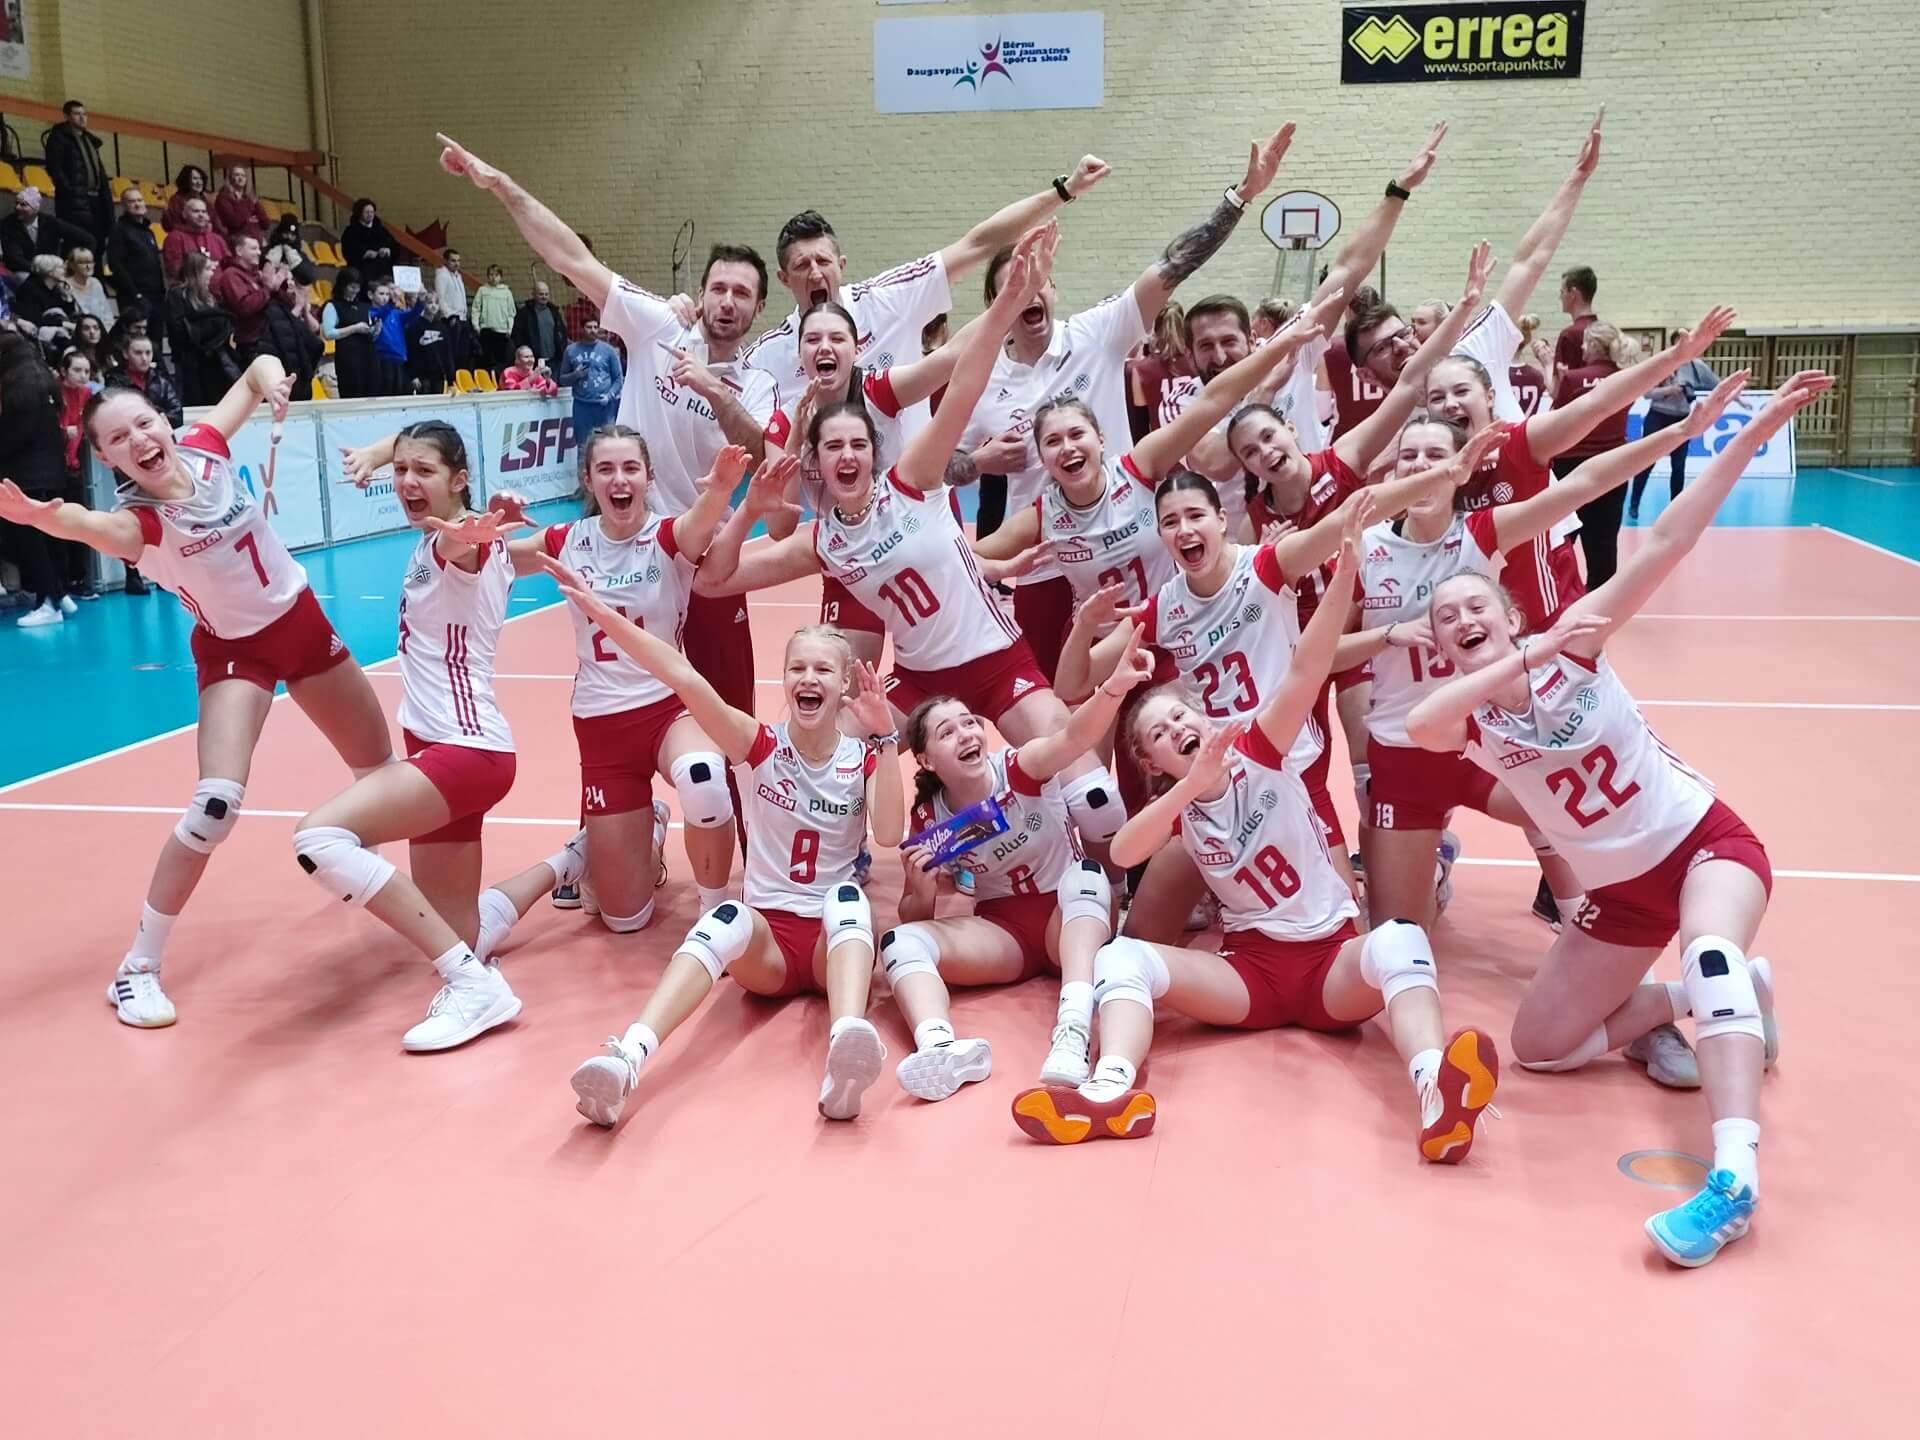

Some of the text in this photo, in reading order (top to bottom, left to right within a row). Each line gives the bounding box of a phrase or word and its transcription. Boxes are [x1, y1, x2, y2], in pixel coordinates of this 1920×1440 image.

[1423, 12, 1568, 60] errea
[1003, 54, 1068, 65] sporta skola
[1018, 47, 1071, 58] jaunatnes
[907, 67, 965, 77] Daugavpils
[1424, 58, 1566, 74] www.sportapunkts.lv
[686, 397, 718, 421] plus
[500, 417, 577, 472] LSFP
[222, 495, 246, 526] plus
[1463, 492, 1490, 511] lus
[181, 530, 222, 557] ORLEN
[871, 530, 904, 563] plus
[1102, 521, 1139, 550] plus
[233, 530, 271, 588] 7
[1059, 550, 1092, 562] ORLEN
[607, 571, 643, 588] plus
[1416, 580, 1434, 600] pl
[878, 566, 942, 628] 10
[1364, 596, 1401, 609] ORLEN
[823, 601, 840, 624] 13
[1193, 650, 1260, 718] 23
[1546, 710, 1584, 749] plus
[1501, 749, 1539, 769] RLEN
[585, 785, 606, 810] 24
[758, 785, 796, 811] ORLEN
[1545, 743, 1641, 829] 22
[809, 798, 849, 816] plus
[1236, 809, 1264, 848] plus
[790, 829, 821, 885] 9
[993, 831, 1029, 861] plus
[1199, 852, 1232, 866] RLEN
[1233, 844, 1302, 910] 18
